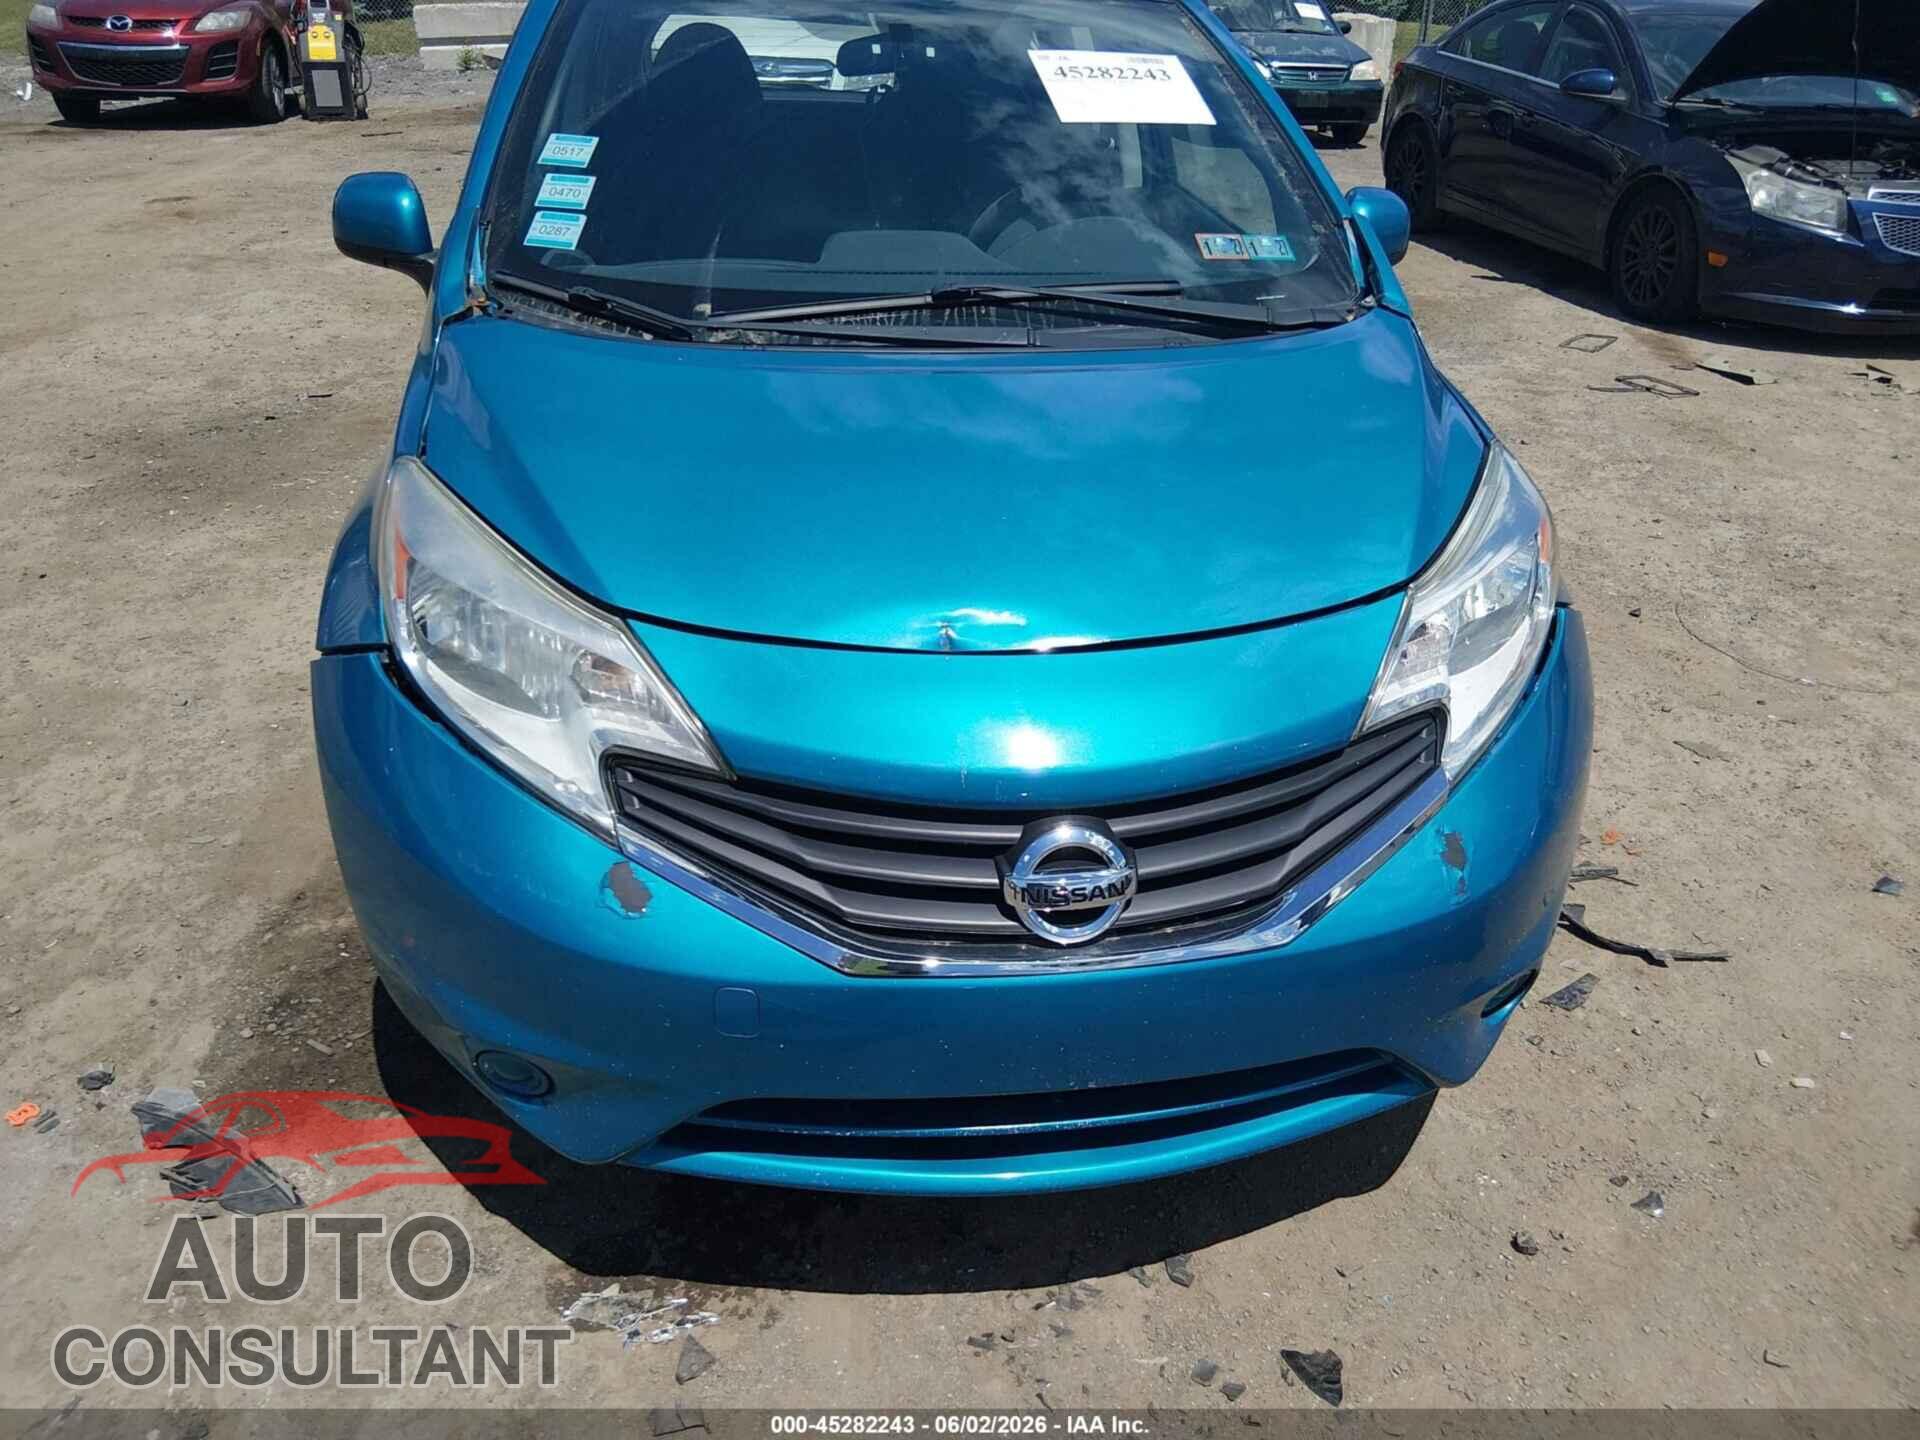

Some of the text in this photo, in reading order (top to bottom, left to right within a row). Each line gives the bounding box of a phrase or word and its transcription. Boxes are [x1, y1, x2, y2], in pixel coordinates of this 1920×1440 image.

[1054, 65, 1172, 81] 45282243
[552, 146, 584, 157] 0517
[548, 187, 582, 198] 0470
[1019, 876, 1127, 906] NISSAN
